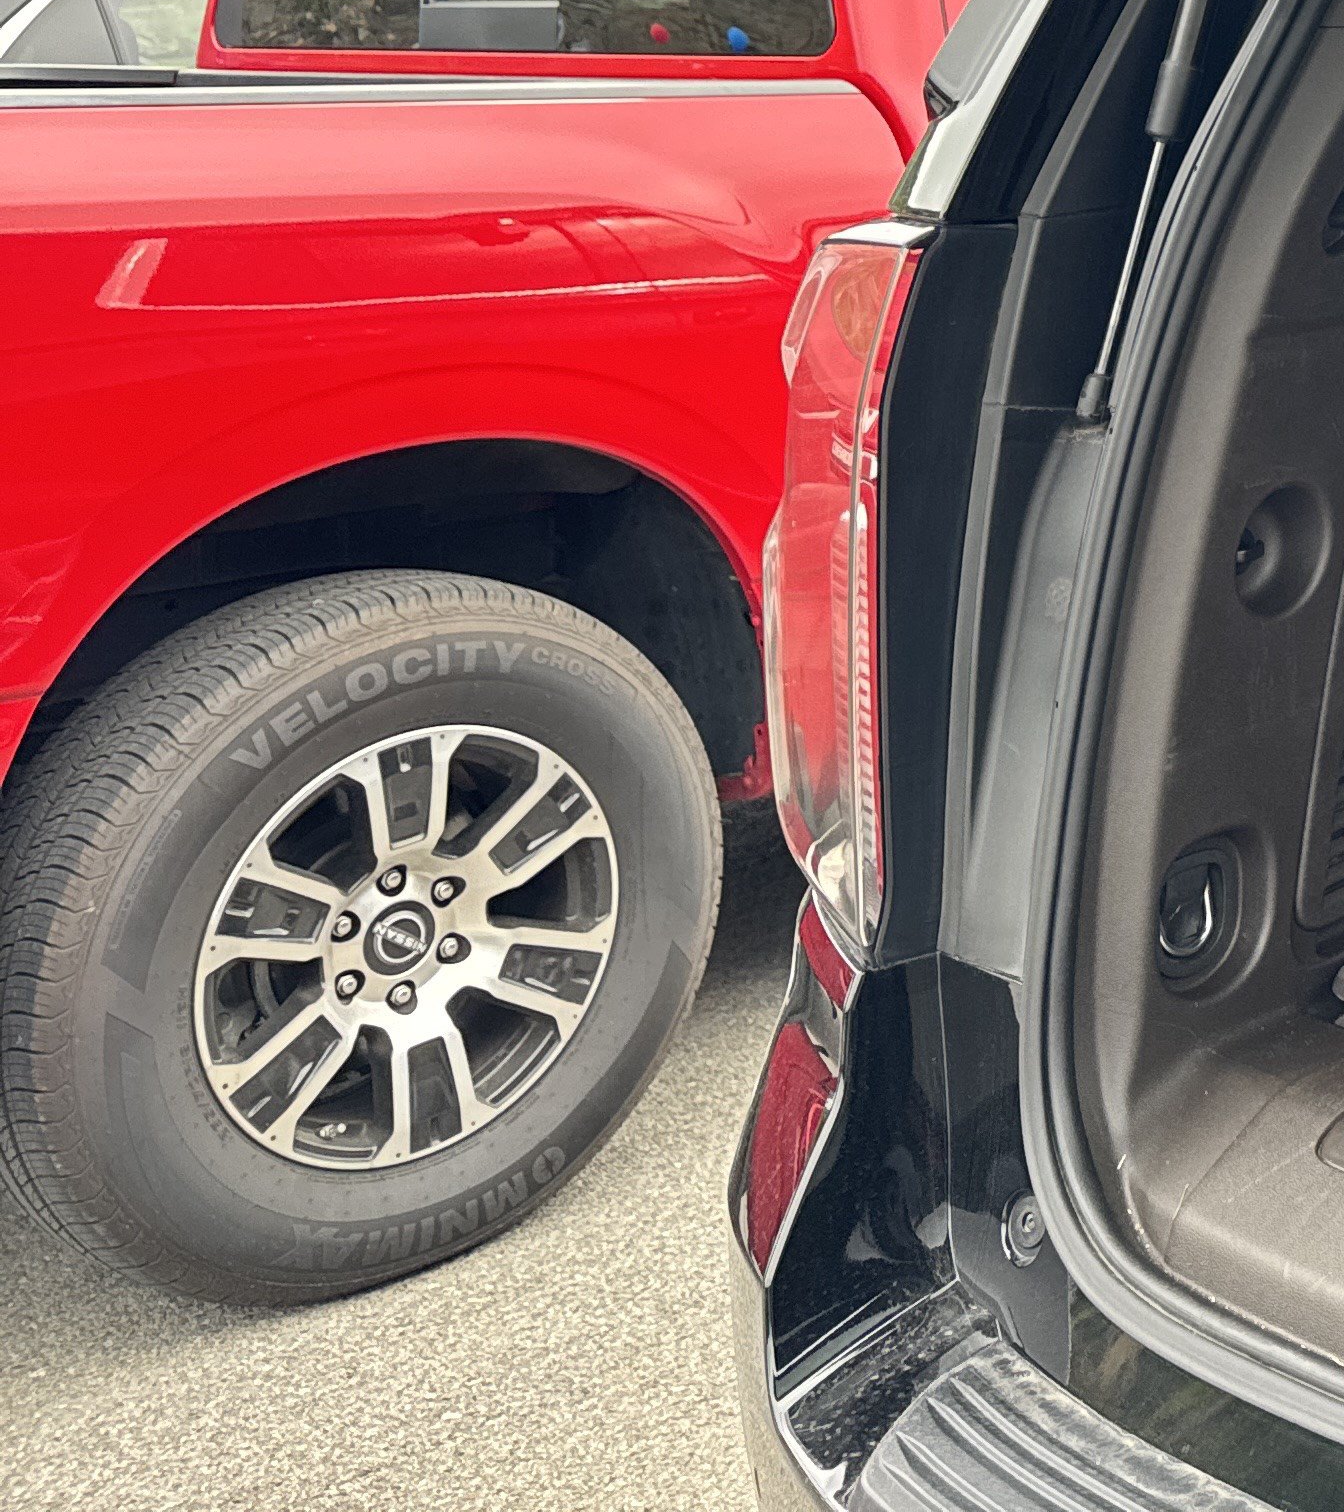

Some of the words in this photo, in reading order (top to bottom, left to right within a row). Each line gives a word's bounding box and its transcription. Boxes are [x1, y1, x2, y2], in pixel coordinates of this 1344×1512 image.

[229, 640, 527, 771] VELOCITY
[531, 645, 618, 696] CROSS
[372, 921, 428, 953] NISSAN
[275, 1146, 567, 1270] OMNIMAX
